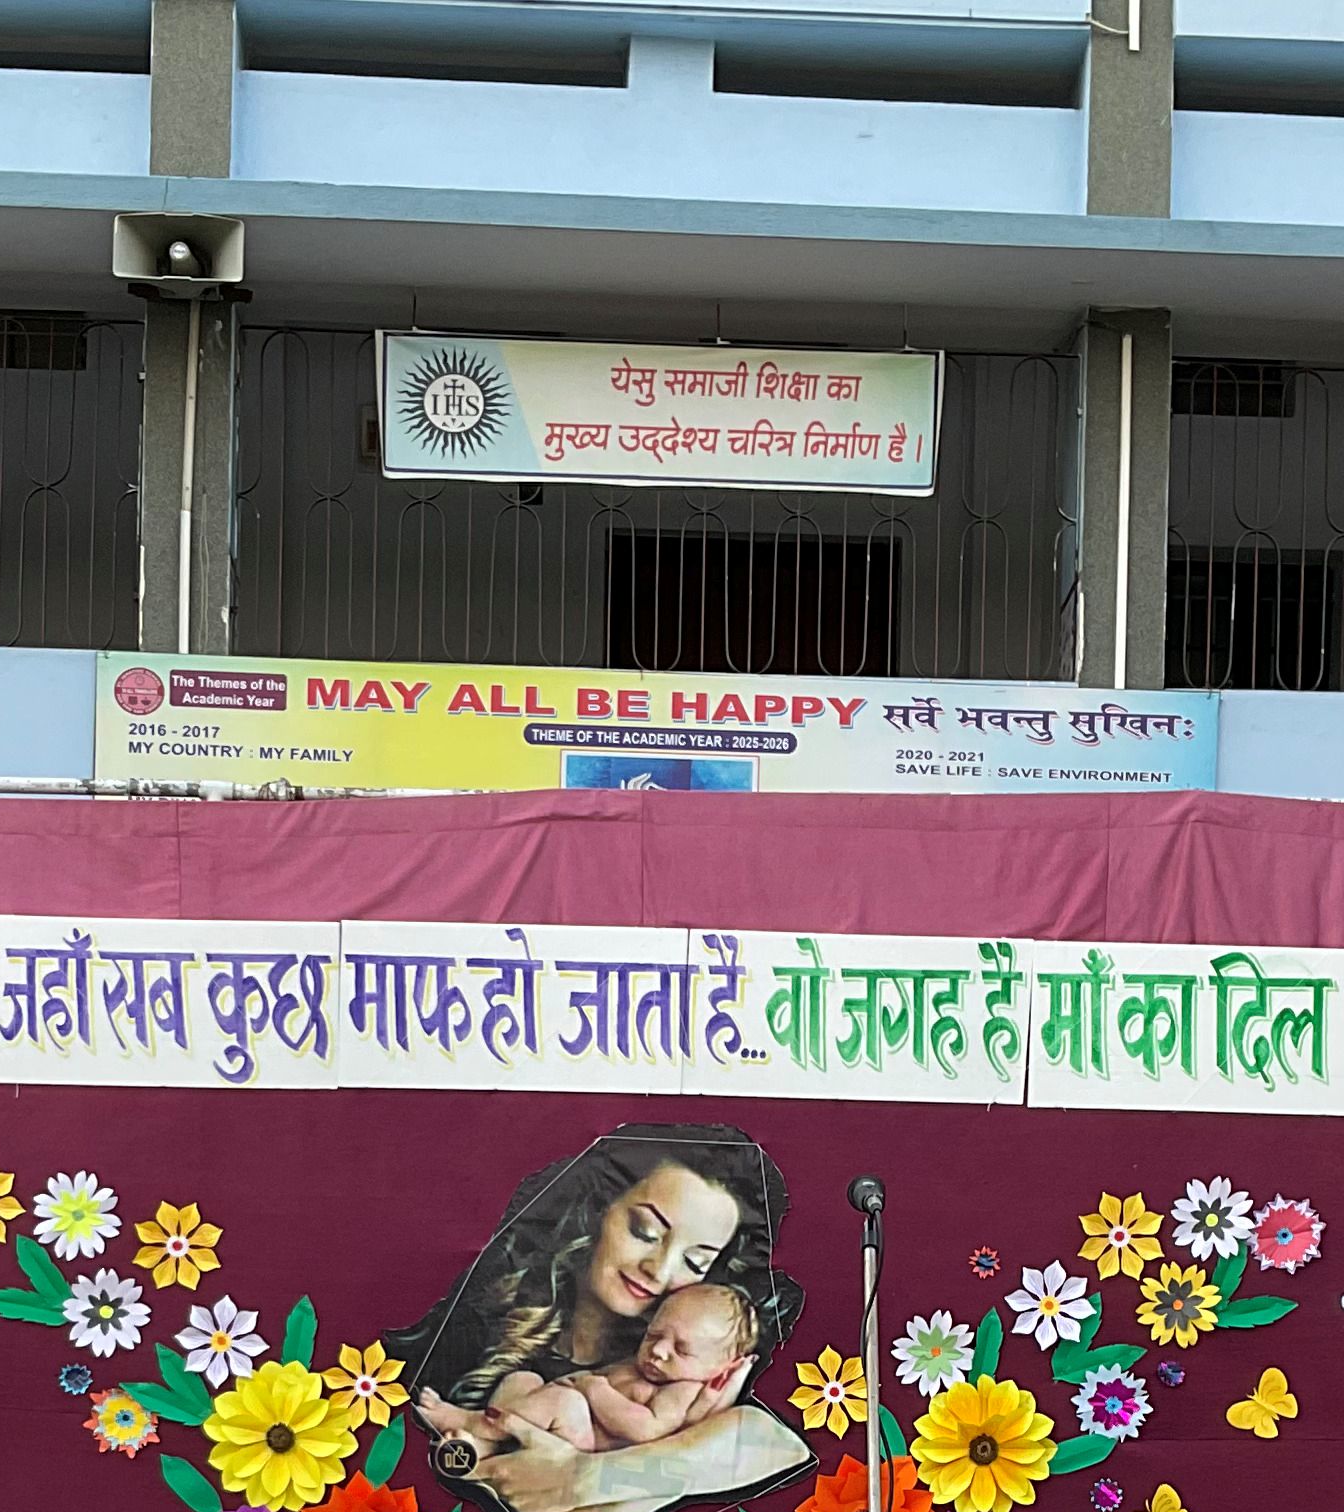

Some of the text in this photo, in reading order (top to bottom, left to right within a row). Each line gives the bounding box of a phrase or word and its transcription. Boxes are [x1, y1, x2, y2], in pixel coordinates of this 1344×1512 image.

[611, 357, 862, 407] येसु समाजी शिक्षा का
[543, 422, 612, 462] मुख्य
[727, 419, 796, 457] चरित्र
[803, 421, 881, 460] निर्माण
[171, 675, 286, 691] The Themes of the
[182, 692, 275, 708] Academic Year
[306, 678, 869, 728] MAY ALL BE HAPPY
[128, 723, 167, 738] 2016
[183, 725, 220, 739] 2017
[883, 696, 944, 733] सर्वे
[955, 706, 1059, 745] भवन्तु
[532, 728, 574, 743] THEME
[576, 730, 594, 743] OF
[596, 731, 620, 744] THE
[622, 732, 687, 746] ACADEMIC
[689, 734, 722, 747] YEAR
[732, 736, 789, 750] 2025-2026
[128, 741, 155, 756] MY
[158, 742, 243, 759] COUNTRY
[259, 746, 286, 760] MY
[289, 748, 353, 763] FAMILY
[895, 750, 933, 761] 2020
[948, 751, 985, 762] 2021
[895, 763, 941, 775] SAVE
[946, 765, 982, 777] LIFE
[998, 767, 1043, 779] SAVE
[1048, 768, 1172, 783] ENVIRONMENT
[99, 950, 195, 1050] सब
[205, 951, 335, 1084] कुछ
[345, 953, 471, 1055] माफ
[465, 927, 543, 1065] हो
[555, 960, 699, 1060] जाता
[837, 968, 972, 1081] जगह
[979, 942, 1024, 1083] है
[1036, 949, 1116, 1081] माँ
[1116, 973, 1199, 1081] का
[1206, 952, 1338, 1091] दिल
